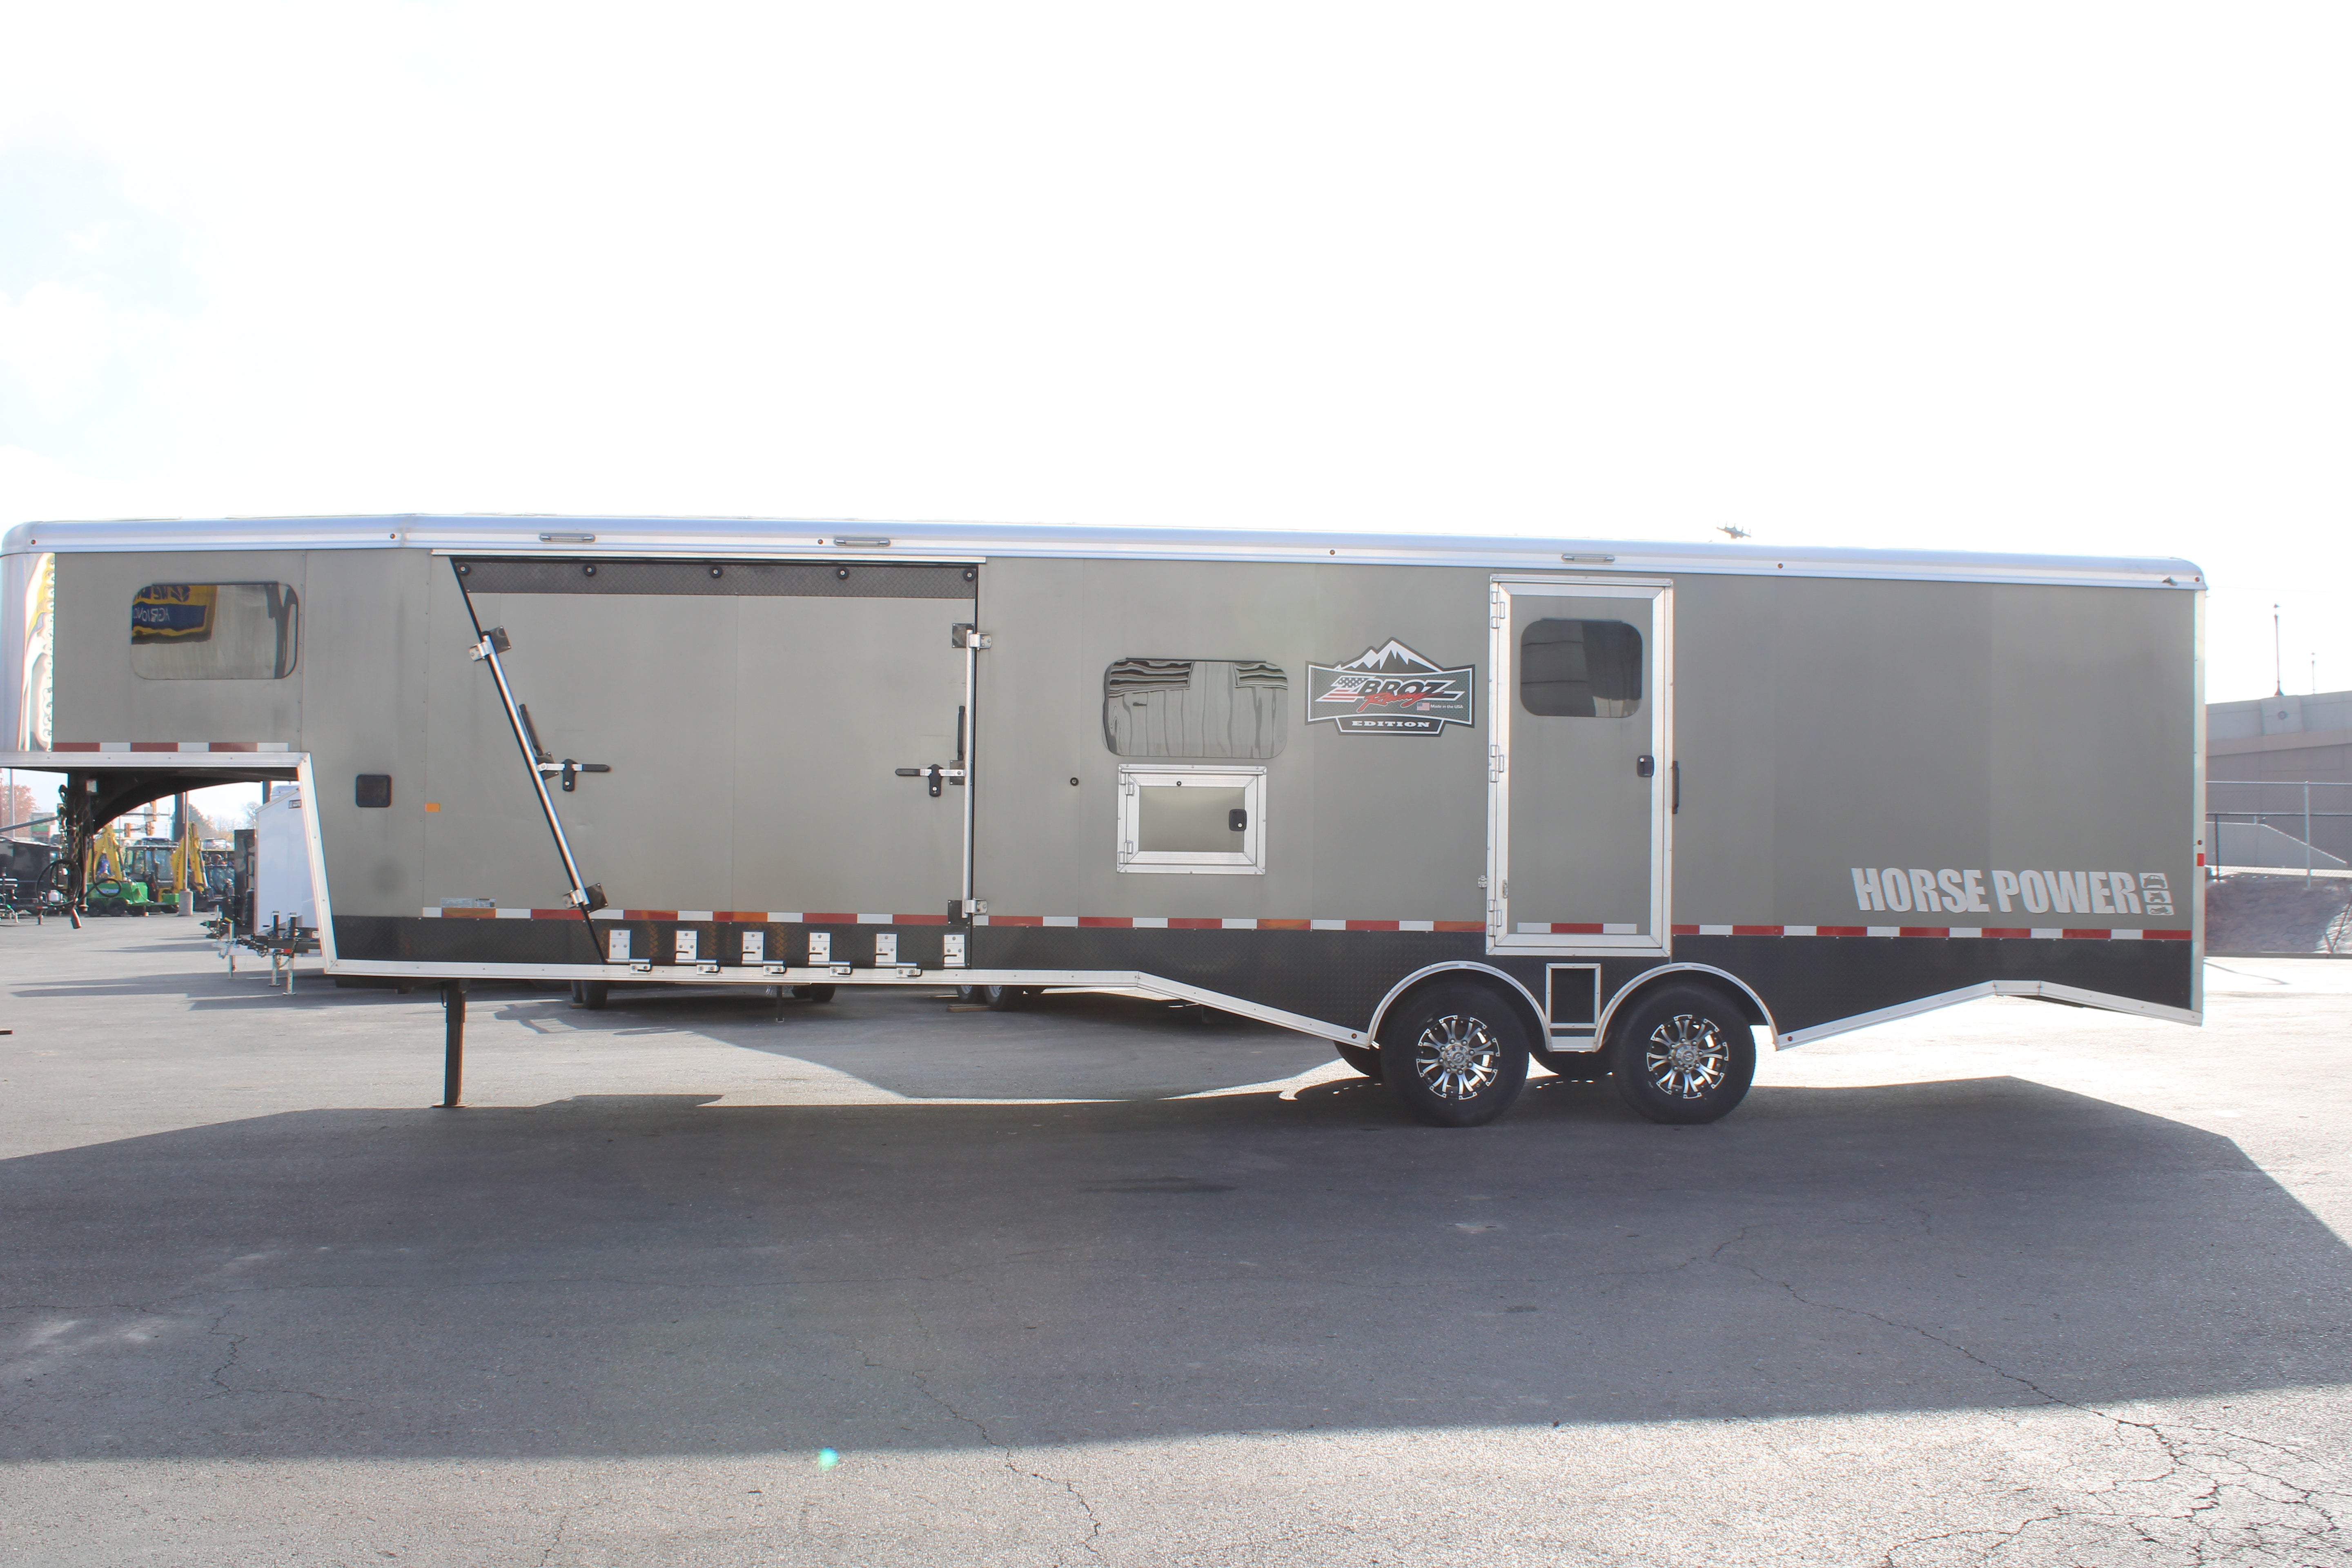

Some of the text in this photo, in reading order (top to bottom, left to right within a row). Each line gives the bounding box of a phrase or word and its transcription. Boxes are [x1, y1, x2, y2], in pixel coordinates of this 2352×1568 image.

[1359, 679, 1463, 700] BROZ
[1851, 868, 2142, 914] HORSE POWER
